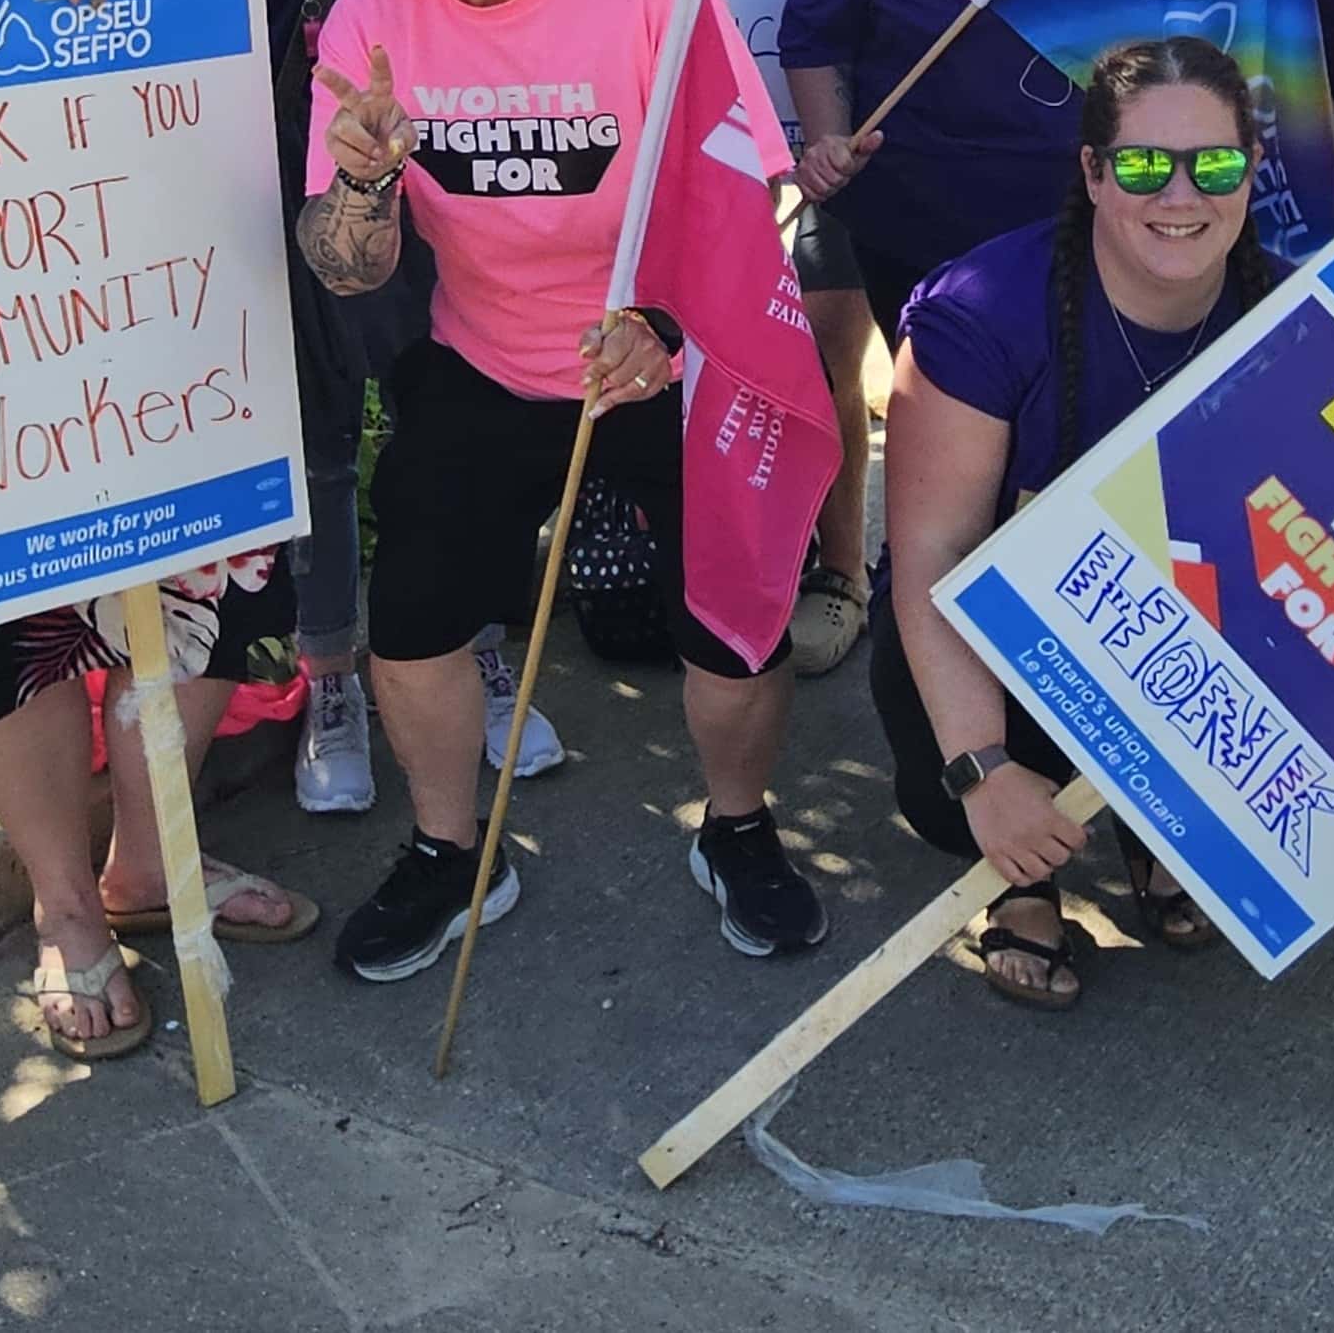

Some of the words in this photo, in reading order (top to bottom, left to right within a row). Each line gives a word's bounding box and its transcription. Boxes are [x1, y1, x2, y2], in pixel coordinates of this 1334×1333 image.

[53, 30, 153, 68] SEFPO
[62, 94, 96, 151] IF
[132, 78, 201, 139] YOU
[412, 82, 596, 116] WORTH
[411, 114, 620, 153] FIGHTING
[472, 158, 562, 193] FOR
[26, 534, 56, 555] We
[60, 520, 108, 547] work
[111, 513, 139, 537] for
[142, 503, 176, 528] you
[31, 535, 134, 579] travaillons
[138, 530, 179, 556] pour
[183, 513, 222, 538] vous
[1037, 637, 1107, 716] Ontario's
[1104, 715, 1151, 765] union
[1018, 649, 1040, 673] Le
[1037, 673, 1102, 742] syndicat
[1098, 740, 1122, 766] de
[1119, 762, 1186, 838] l'Ontario
